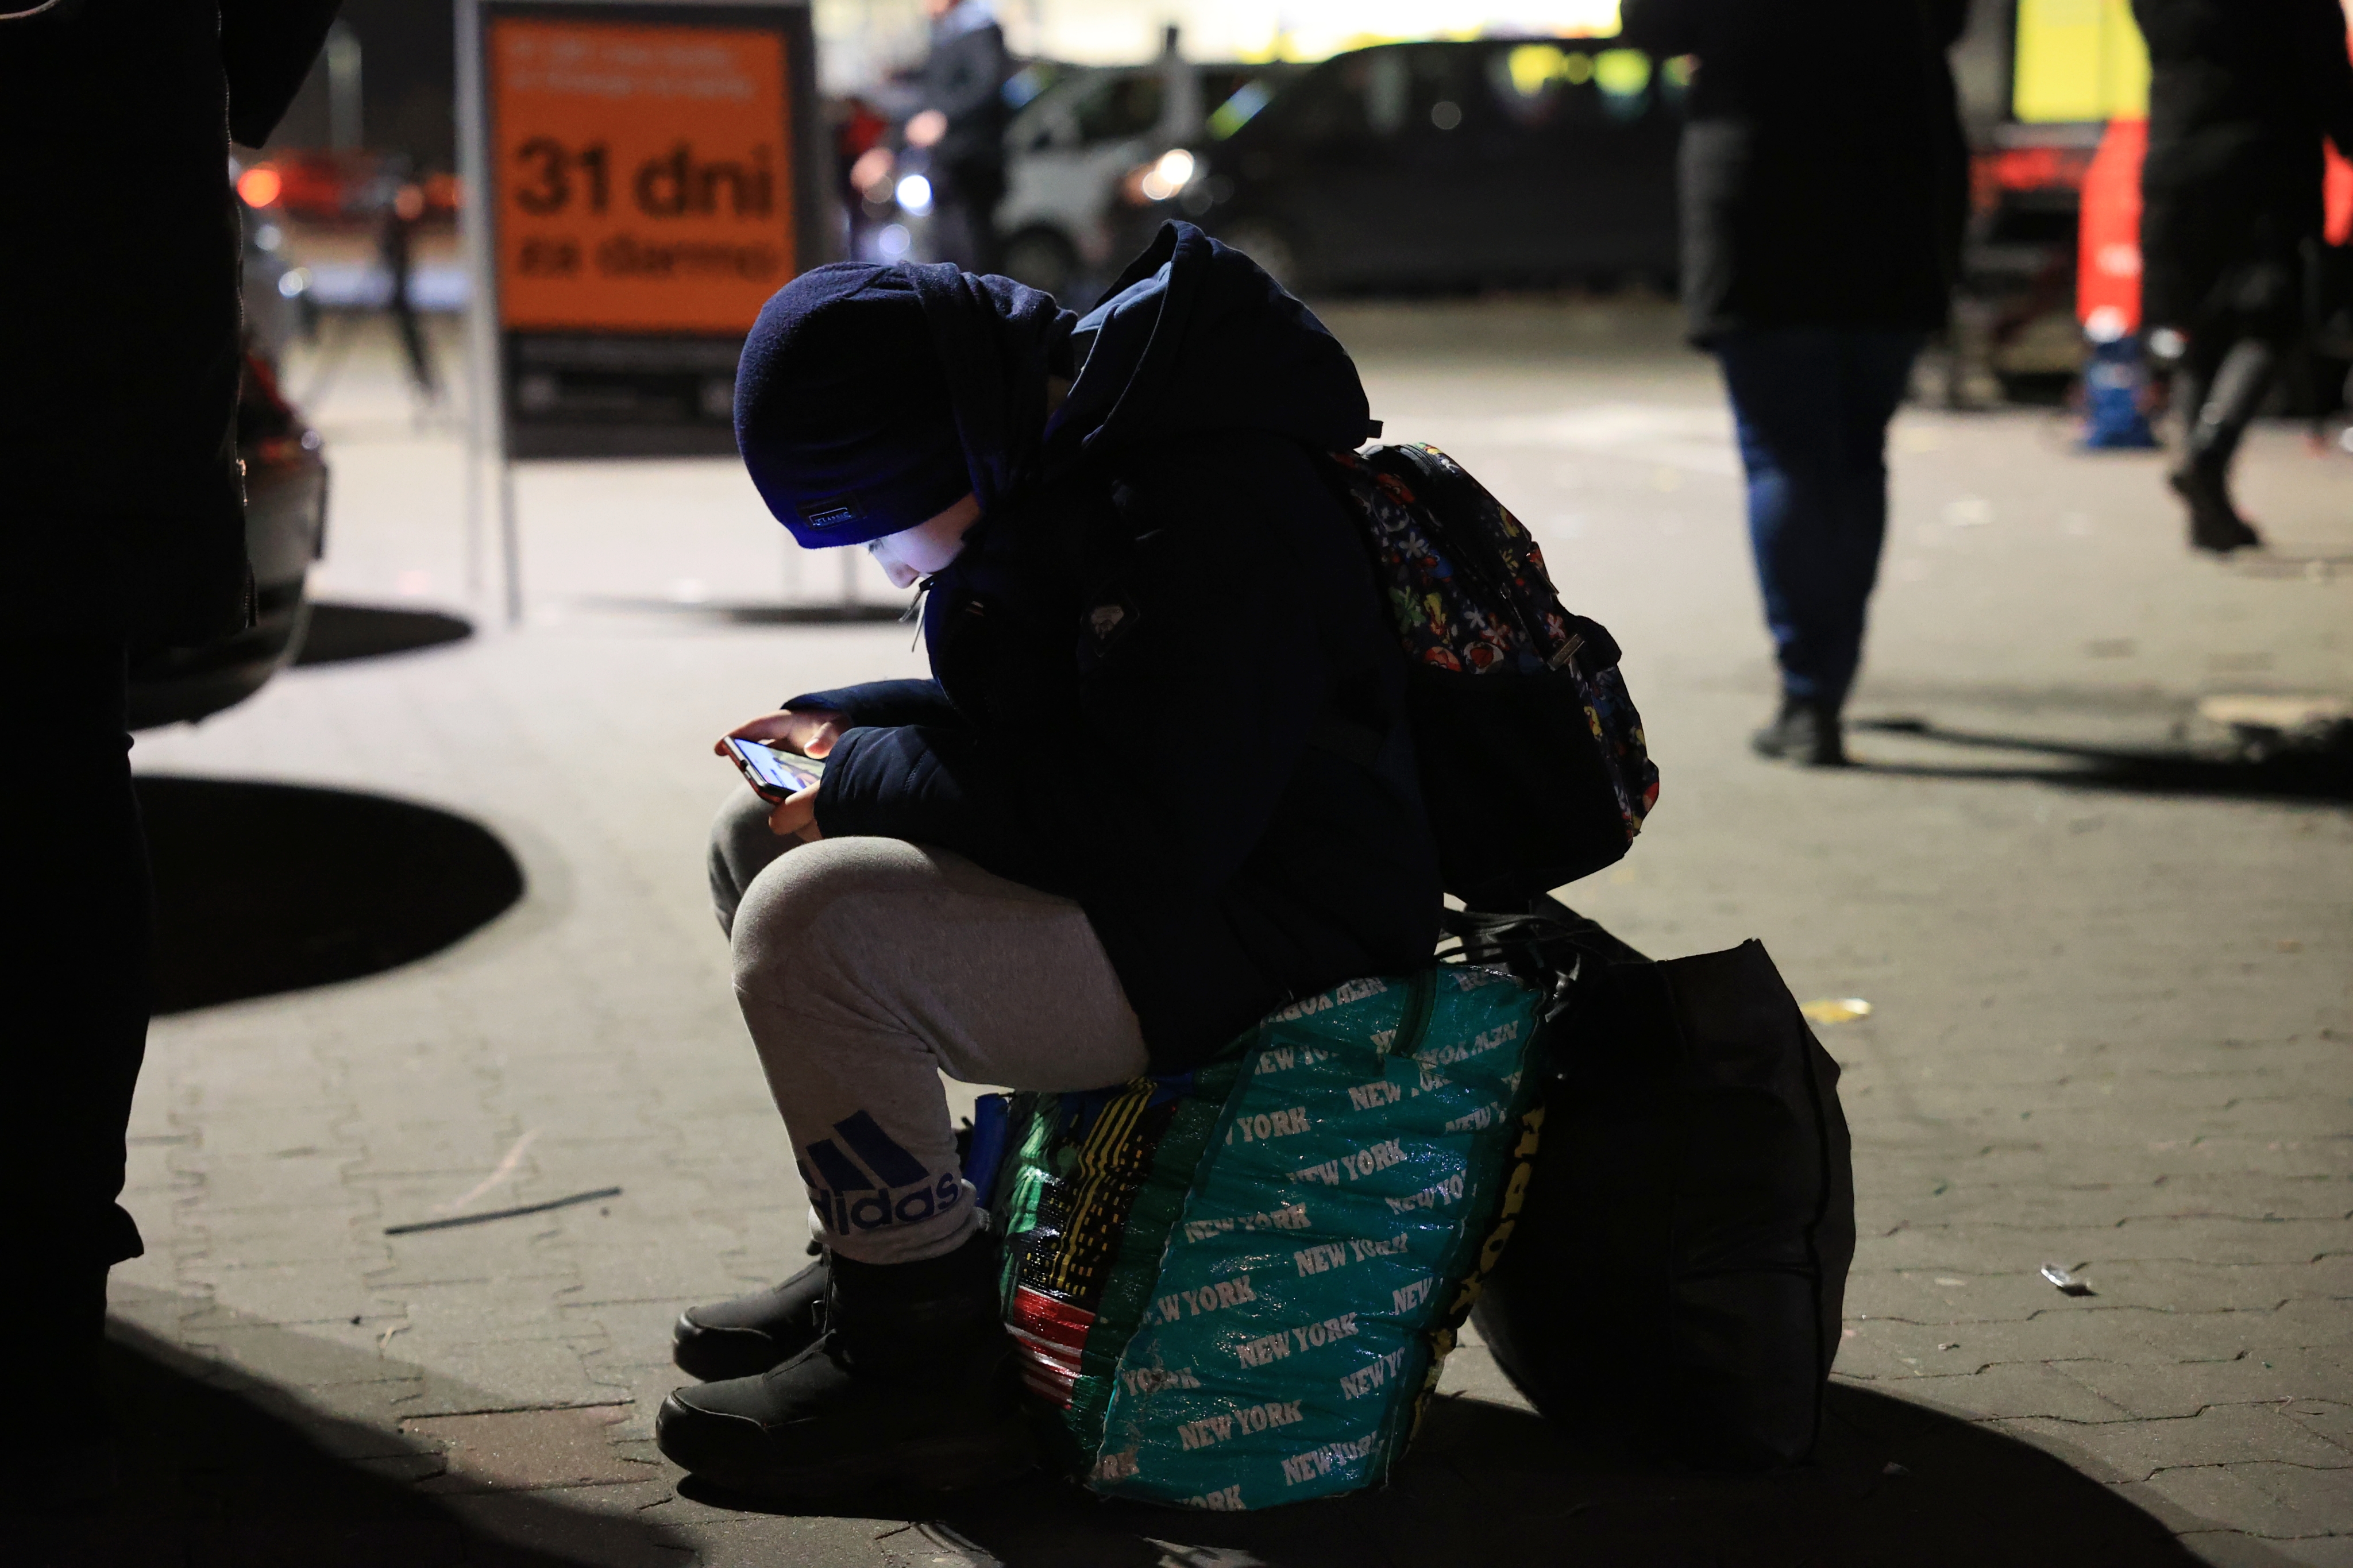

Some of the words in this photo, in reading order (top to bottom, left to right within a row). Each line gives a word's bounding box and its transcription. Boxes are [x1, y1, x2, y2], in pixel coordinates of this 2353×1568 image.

[516, 136, 611, 216] 31
[633, 138, 776, 221] dni
[1348, 1080, 1401, 1111] NEW
[1236, 1106, 1311, 1142] YORK
[1341, 1137, 1407, 1181] YORK
[810, 1172, 959, 1236] didas
[1184, 1218, 1235, 1243] NEW
[1237, 1202, 1312, 1230] YORK
[1384, 1187, 1436, 1215] NEW
[1293, 1241, 1346, 1277] NEW
[1347, 1232, 1409, 1262] YORK
[1181, 1275, 1257, 1316] YORK
[1236, 1330, 1291, 1369] NEW
[1291, 1311, 1359, 1353] YORK
[1340, 1356, 1384, 1401] NEW
[1177, 1413, 1232, 1451] NEW
[1233, 1399, 1303, 1435] YORK
[1281, 1445, 1332, 1486] NEW
